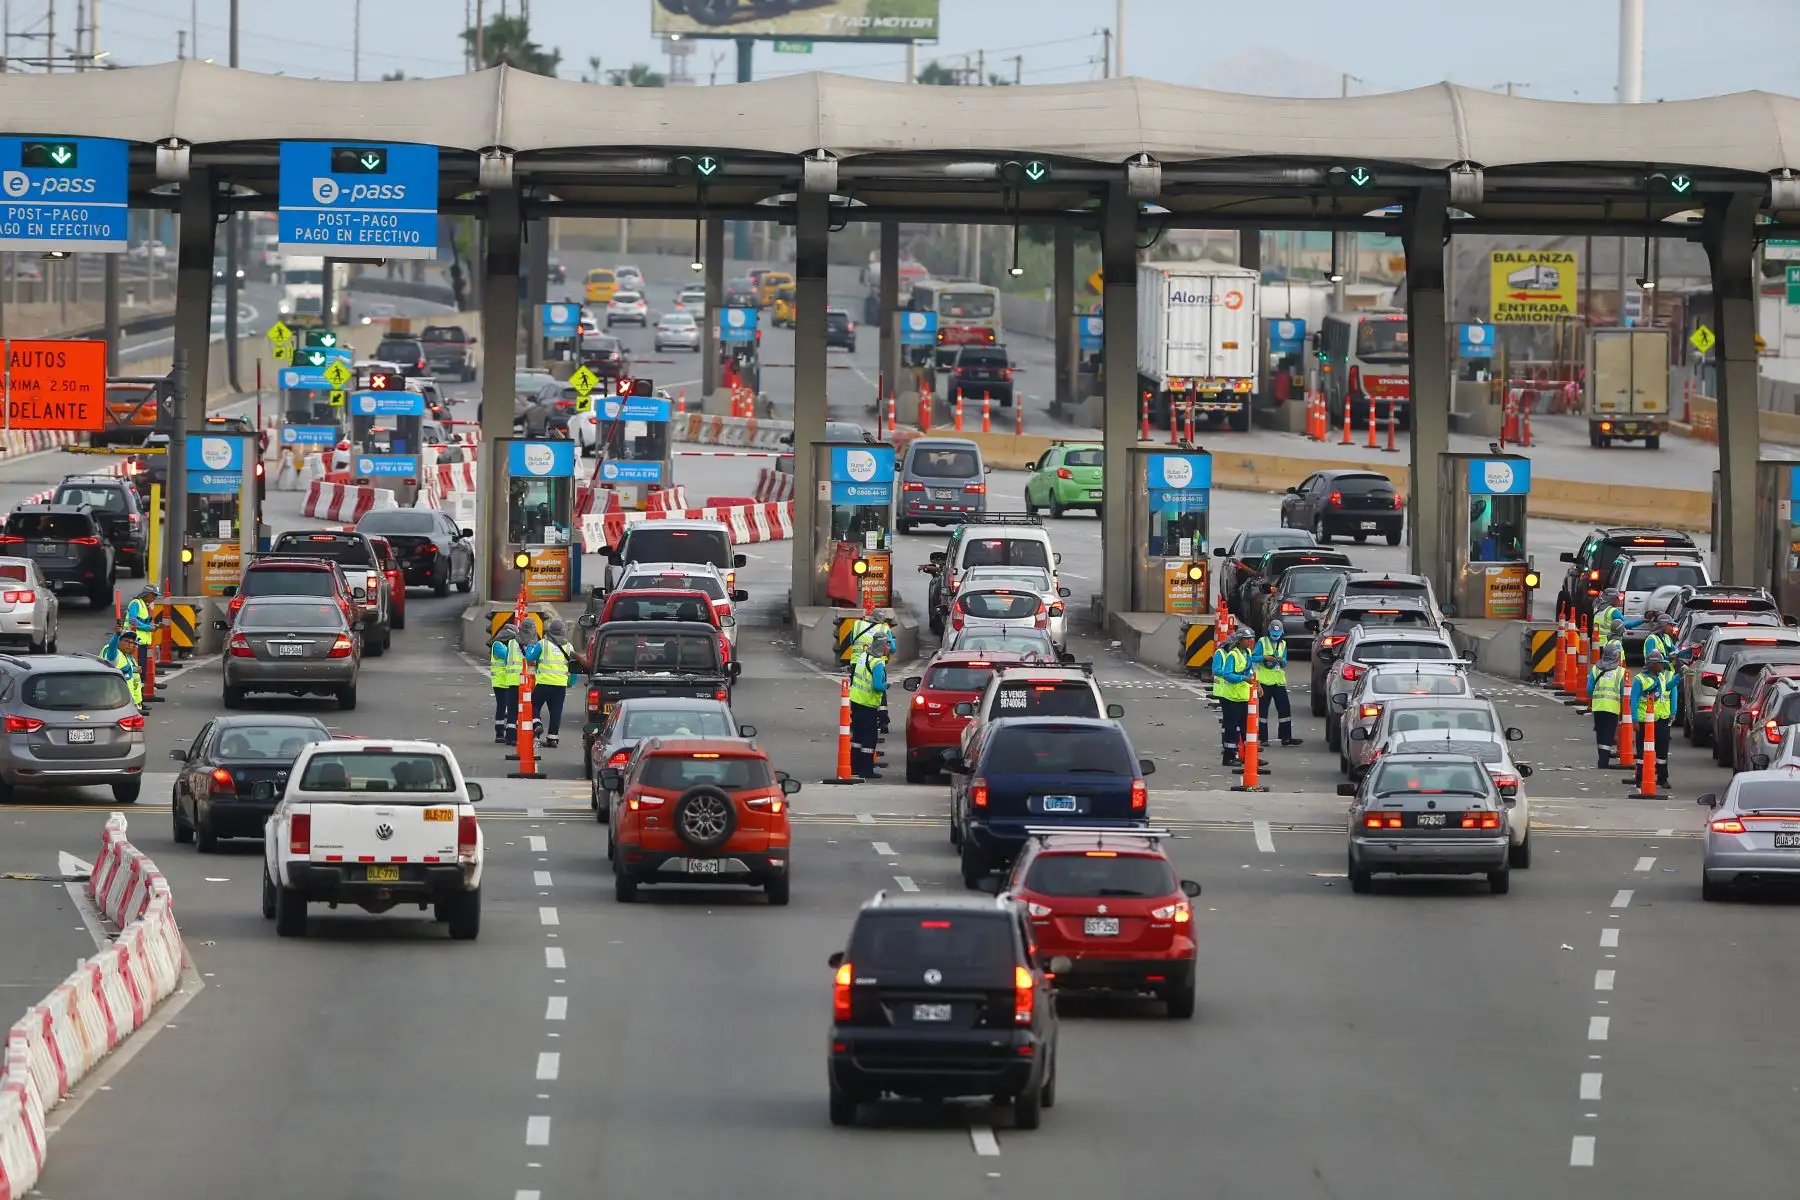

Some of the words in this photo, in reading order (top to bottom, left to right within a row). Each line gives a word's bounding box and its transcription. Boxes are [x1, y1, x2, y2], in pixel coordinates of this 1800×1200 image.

[8, 174, 97, 196] e-pass
[317, 181, 406, 203] e-pass
[8, 208, 89, 221] POST-PAGO
[318, 213, 398, 227] POST-PAGO
[28, 223, 43, 235] EN
[50, 224, 111, 237] EFECTIVO
[295, 228, 329, 240] PAGO
[337, 229, 352, 242] EN
[359, 229, 420, 243] EFECTIVO
[1494, 253, 1574, 263] BALANZA
[1499, 303, 1569, 313] ENTRADA
[10, 351, 66, 368] AUTOS
[51, 380, 76, 392] 2.50
[80, 384, 90, 392] m
[1001, 690, 1008, 698] SE
[424, 808, 453, 821] BLE-770
[1776, 834, 1800, 845] AUA-19
